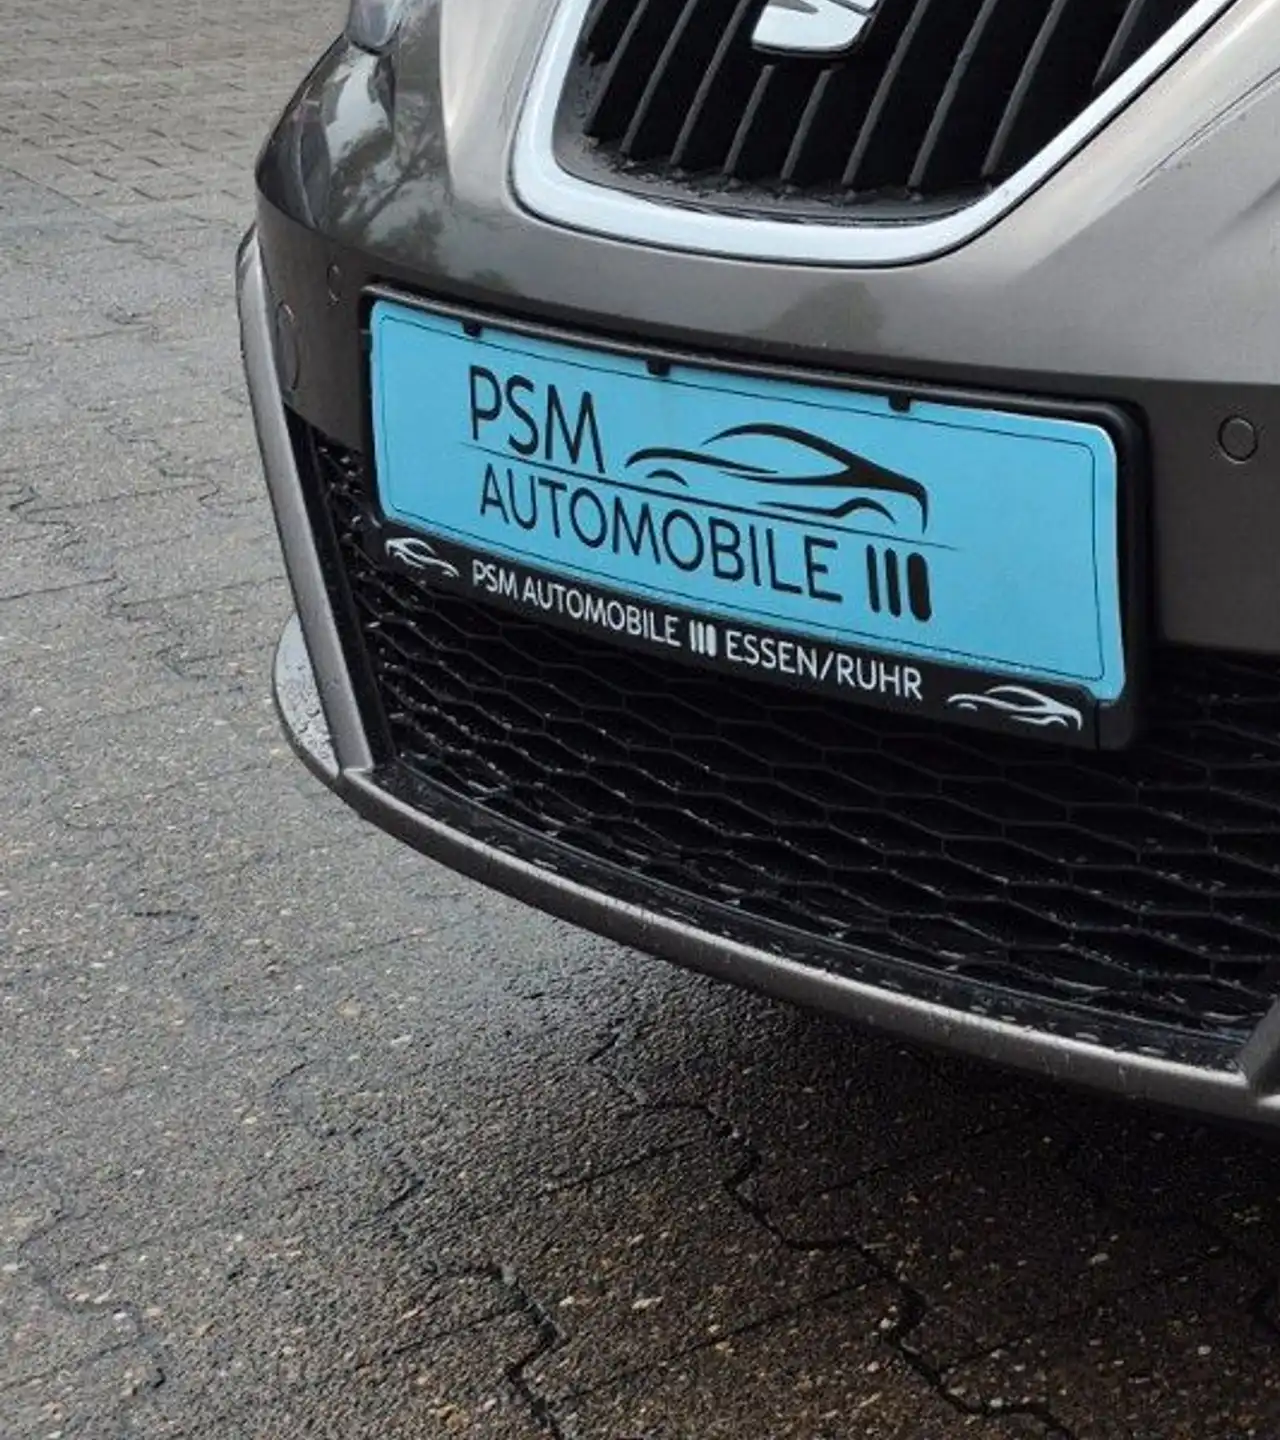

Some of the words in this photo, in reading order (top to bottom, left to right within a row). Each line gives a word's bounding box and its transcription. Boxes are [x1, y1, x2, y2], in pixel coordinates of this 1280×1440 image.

[469, 365, 605, 474] PSM
[479, 462, 842, 602] AUTOMOBILE
[472, 560, 518, 601] PSM
[522, 578, 680, 648] AUTOMOBILE
[725, 631, 923, 702] ESSEN/RUHR
